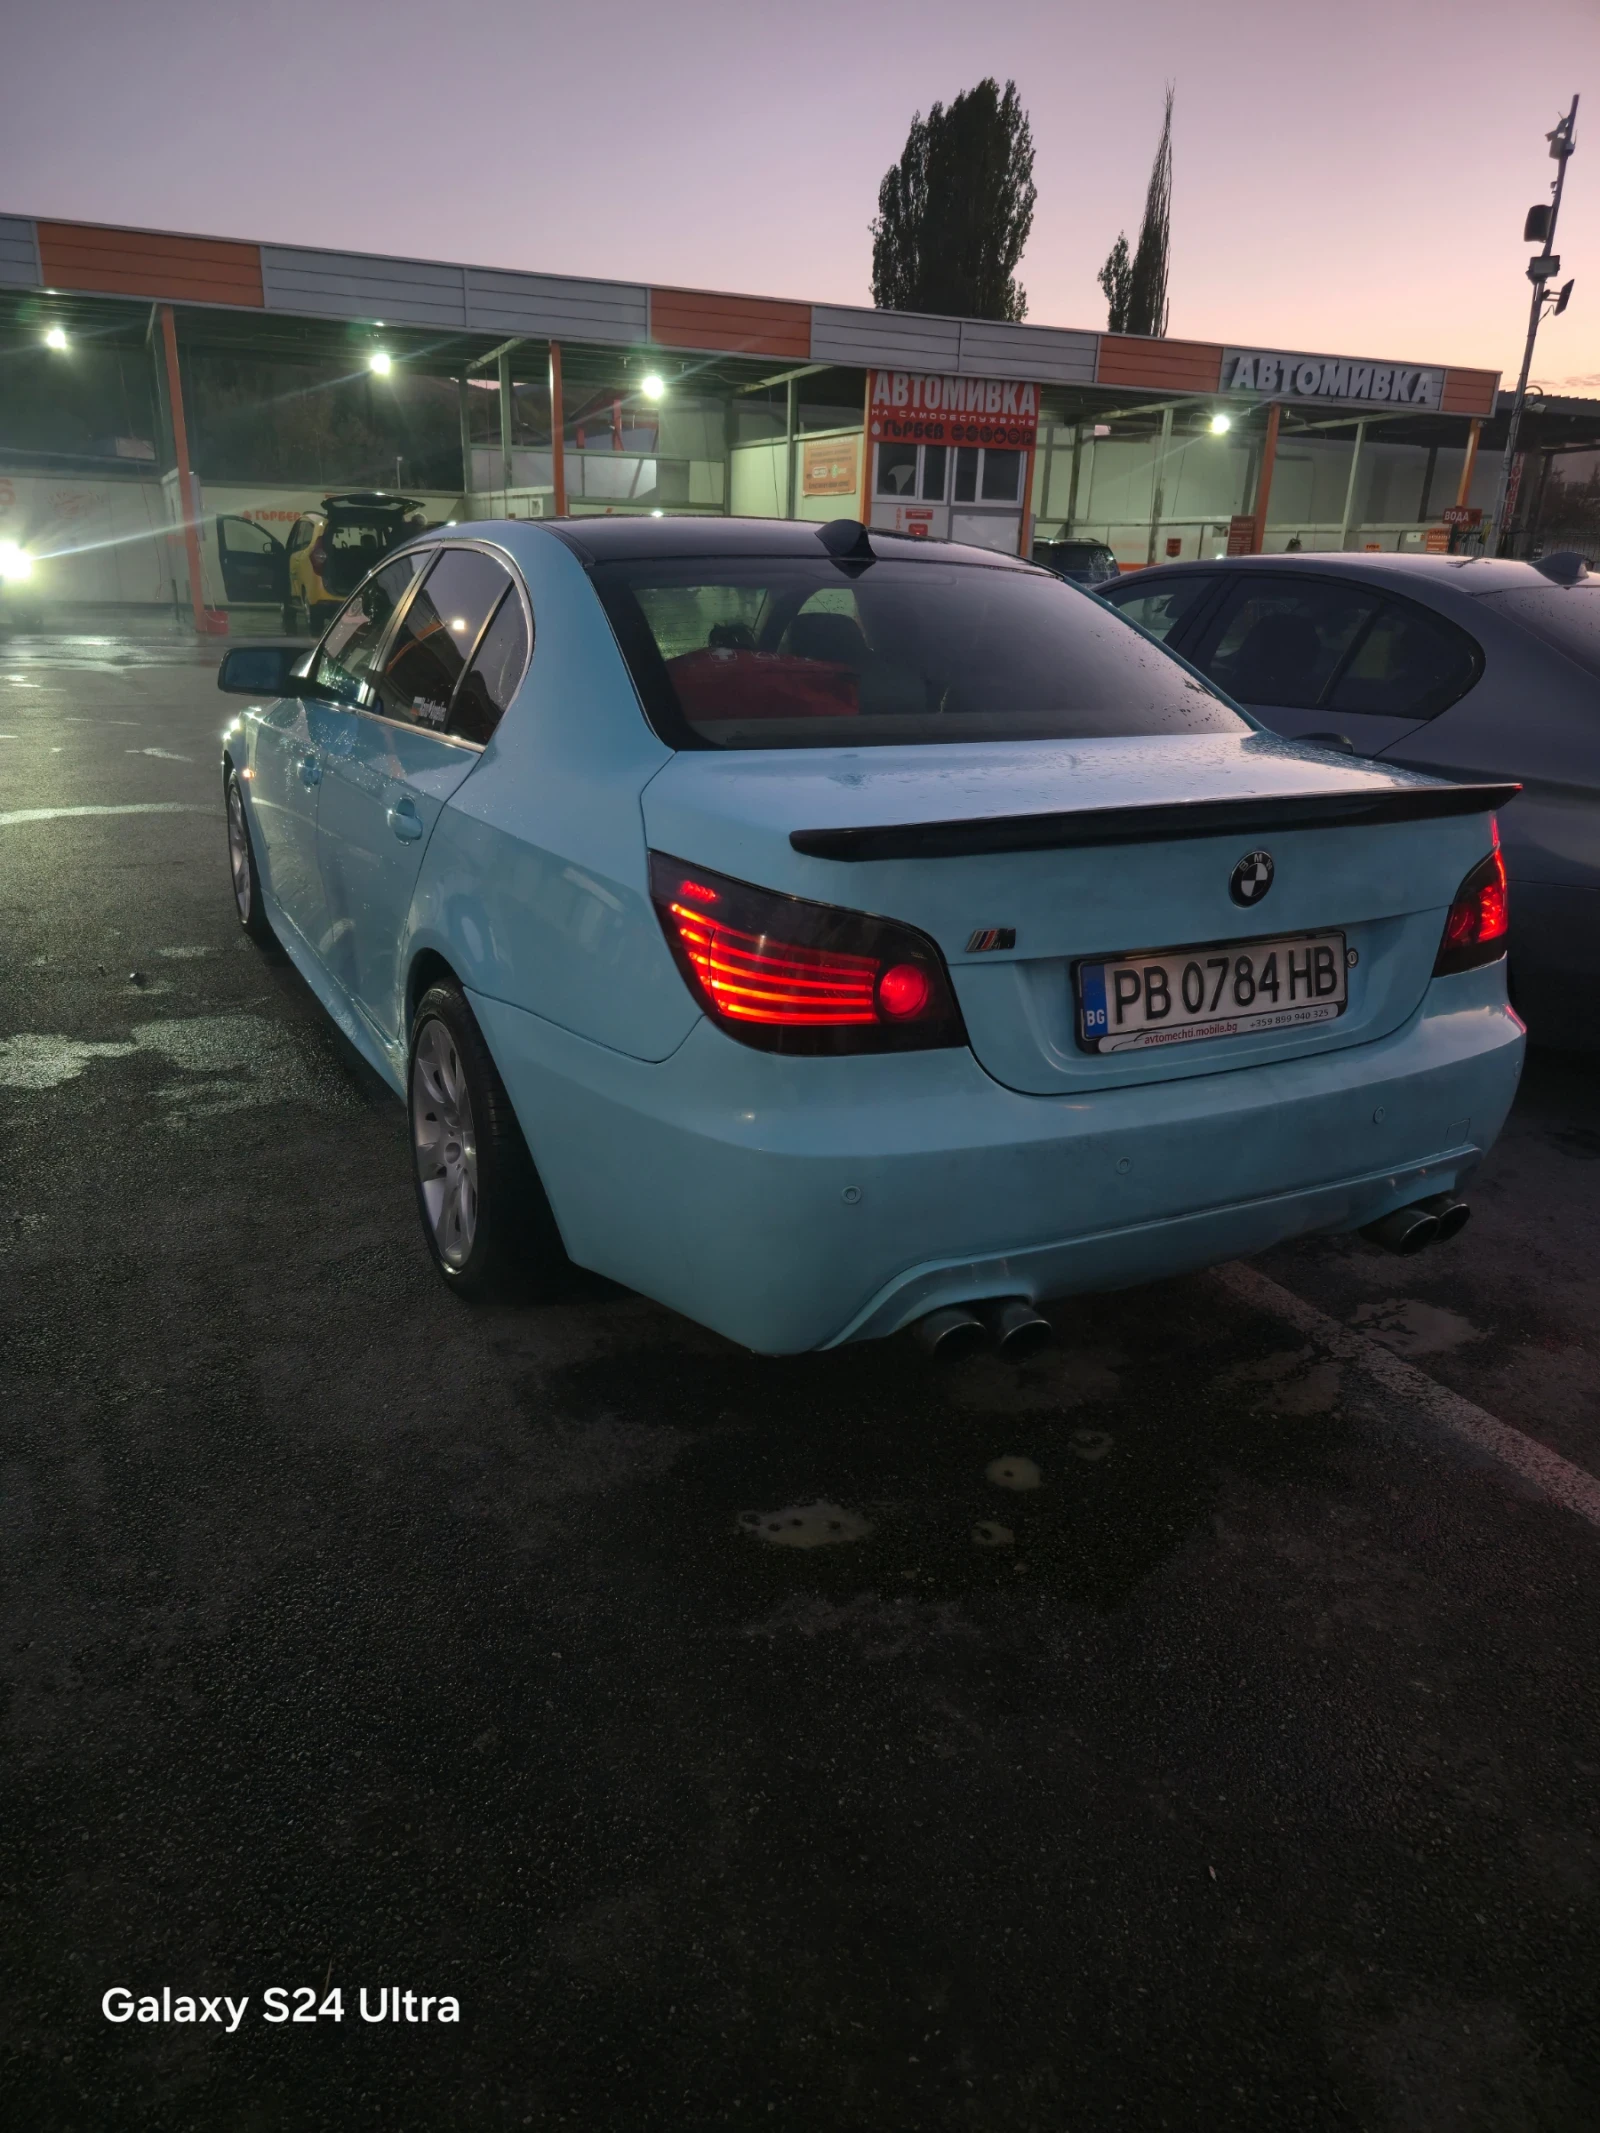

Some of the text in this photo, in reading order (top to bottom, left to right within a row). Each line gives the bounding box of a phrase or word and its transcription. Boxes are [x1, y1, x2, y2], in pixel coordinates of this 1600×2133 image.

[1230, 356, 1433, 402] АВТОМИВКА
[872, 371, 1036, 416] АВТОМИВКА
[883, 419, 945, 440] ГЪРБЕВ
[1444, 511, 1469, 523] ВОДА
[1113, 945, 1338, 1025] PB 0784 HB
[1086, 1009, 1105, 1027] BG
[1250, 1008, 1329, 1028] +359 899 940 325
[1144, 1021, 1238, 1045] avtomechti.mobile.bg
